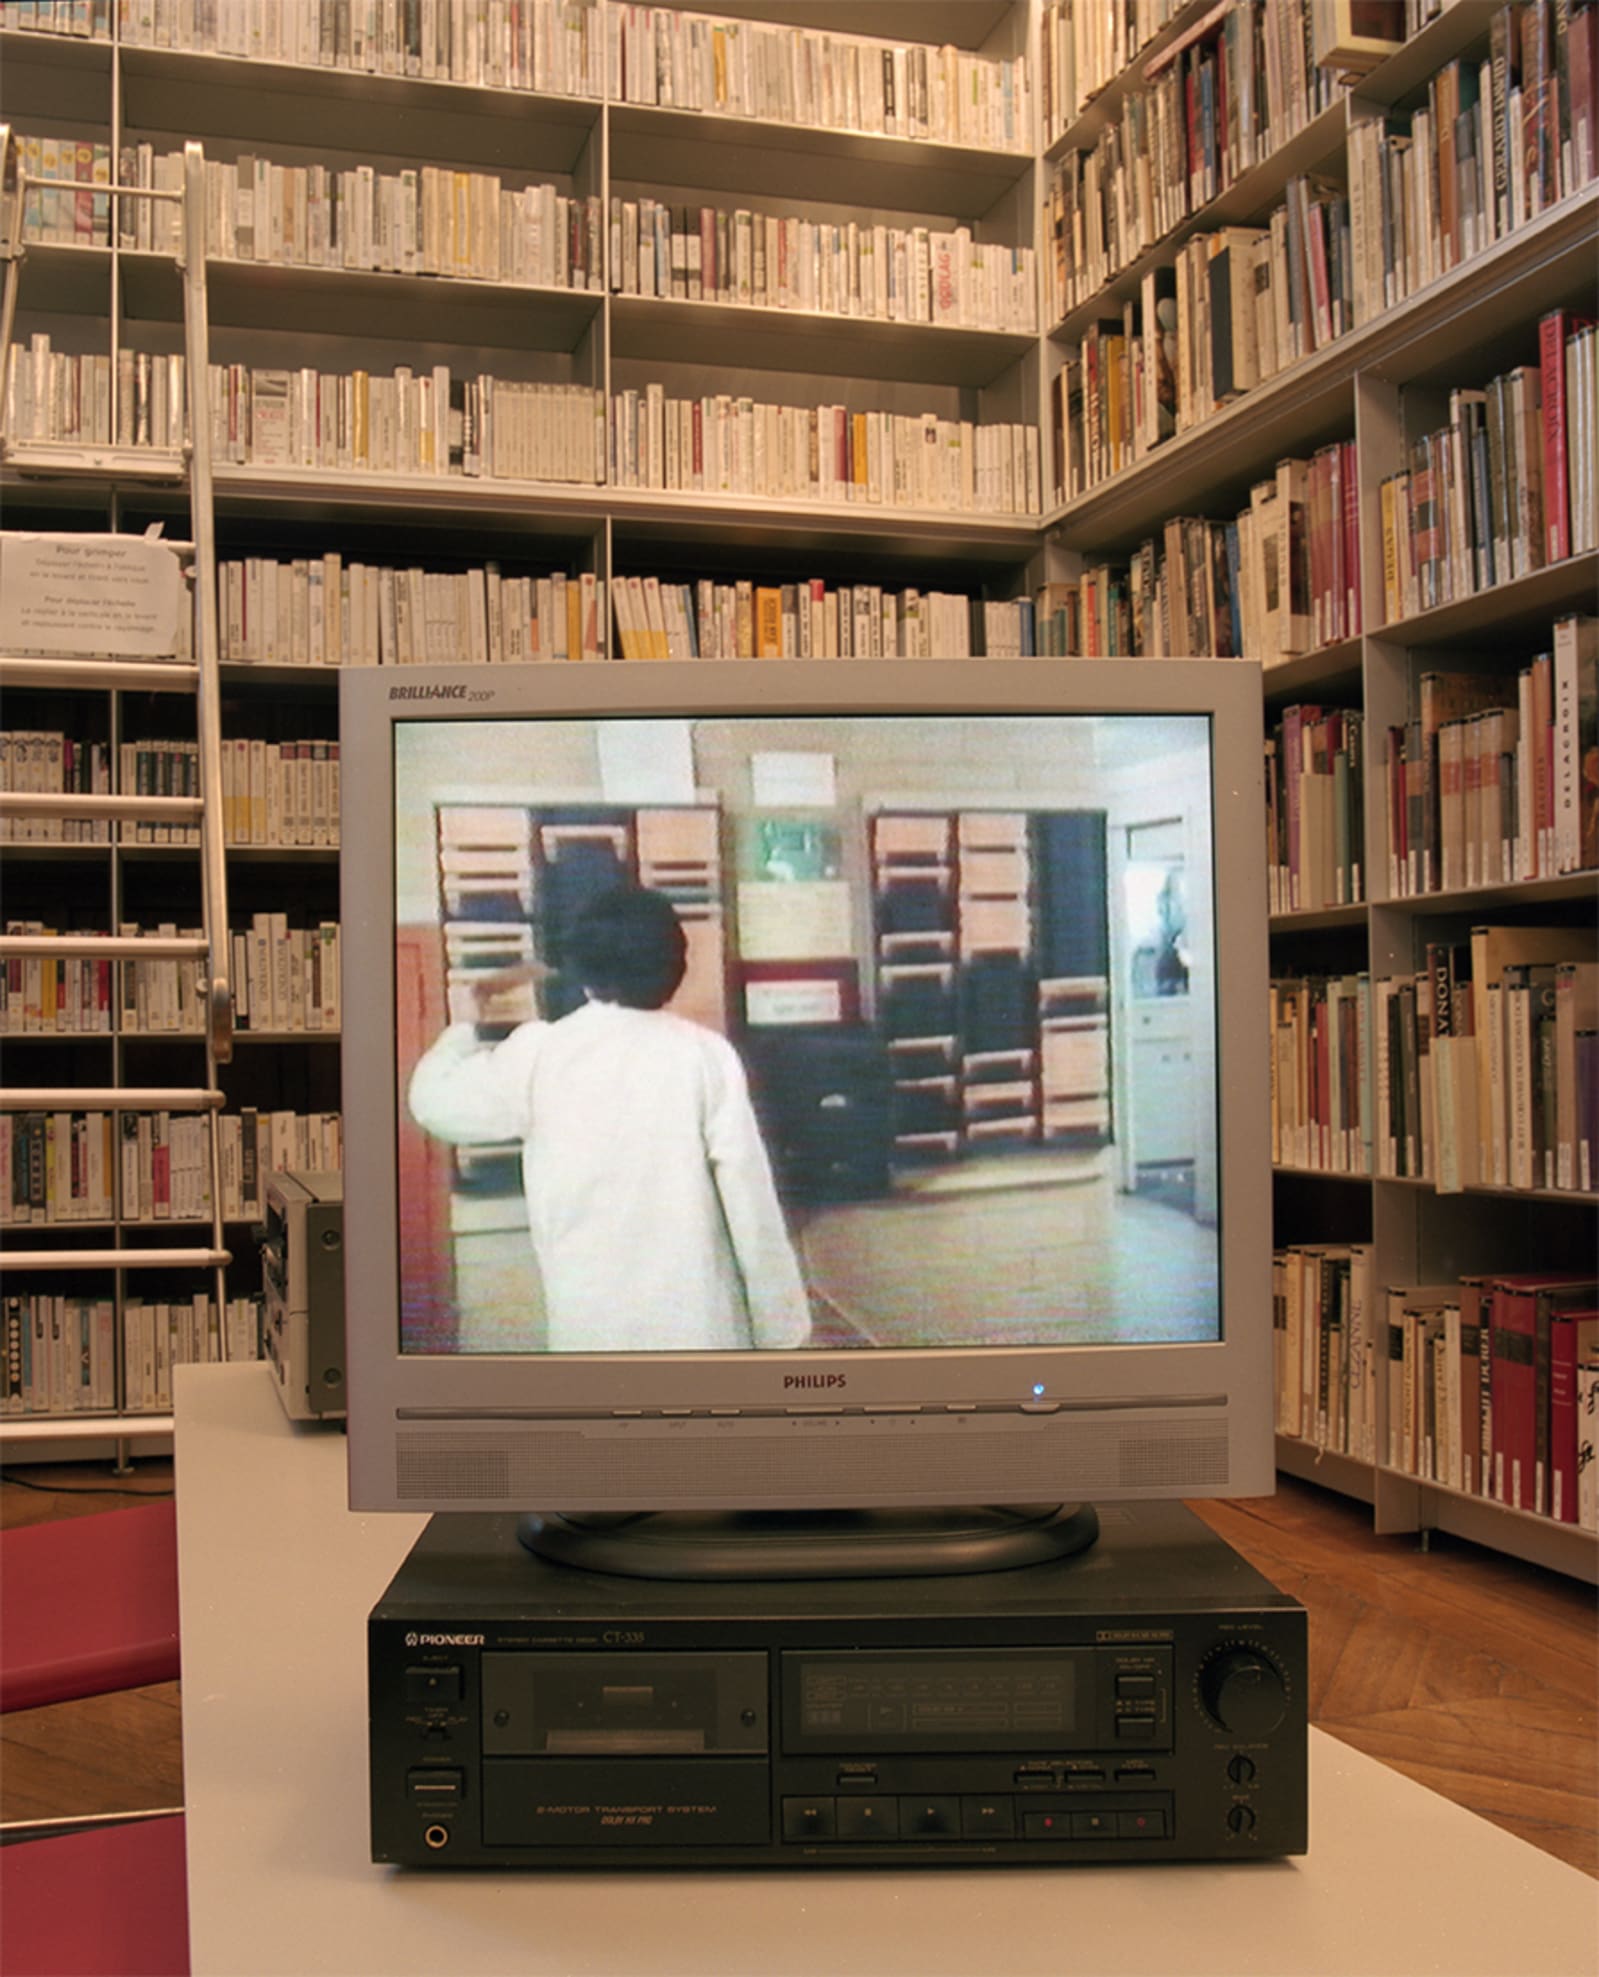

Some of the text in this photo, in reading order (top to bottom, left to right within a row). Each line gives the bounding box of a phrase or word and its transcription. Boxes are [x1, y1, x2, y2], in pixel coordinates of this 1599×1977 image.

[389, 684, 468, 700] BRILLIANCE
[784, 1374, 847, 1388] PHILIPS
[420, 1634, 485, 1646] PIONEER
[595, 1805, 663, 1814] TRANSPORT
[666, 1805, 717, 1814] SYSTEM
